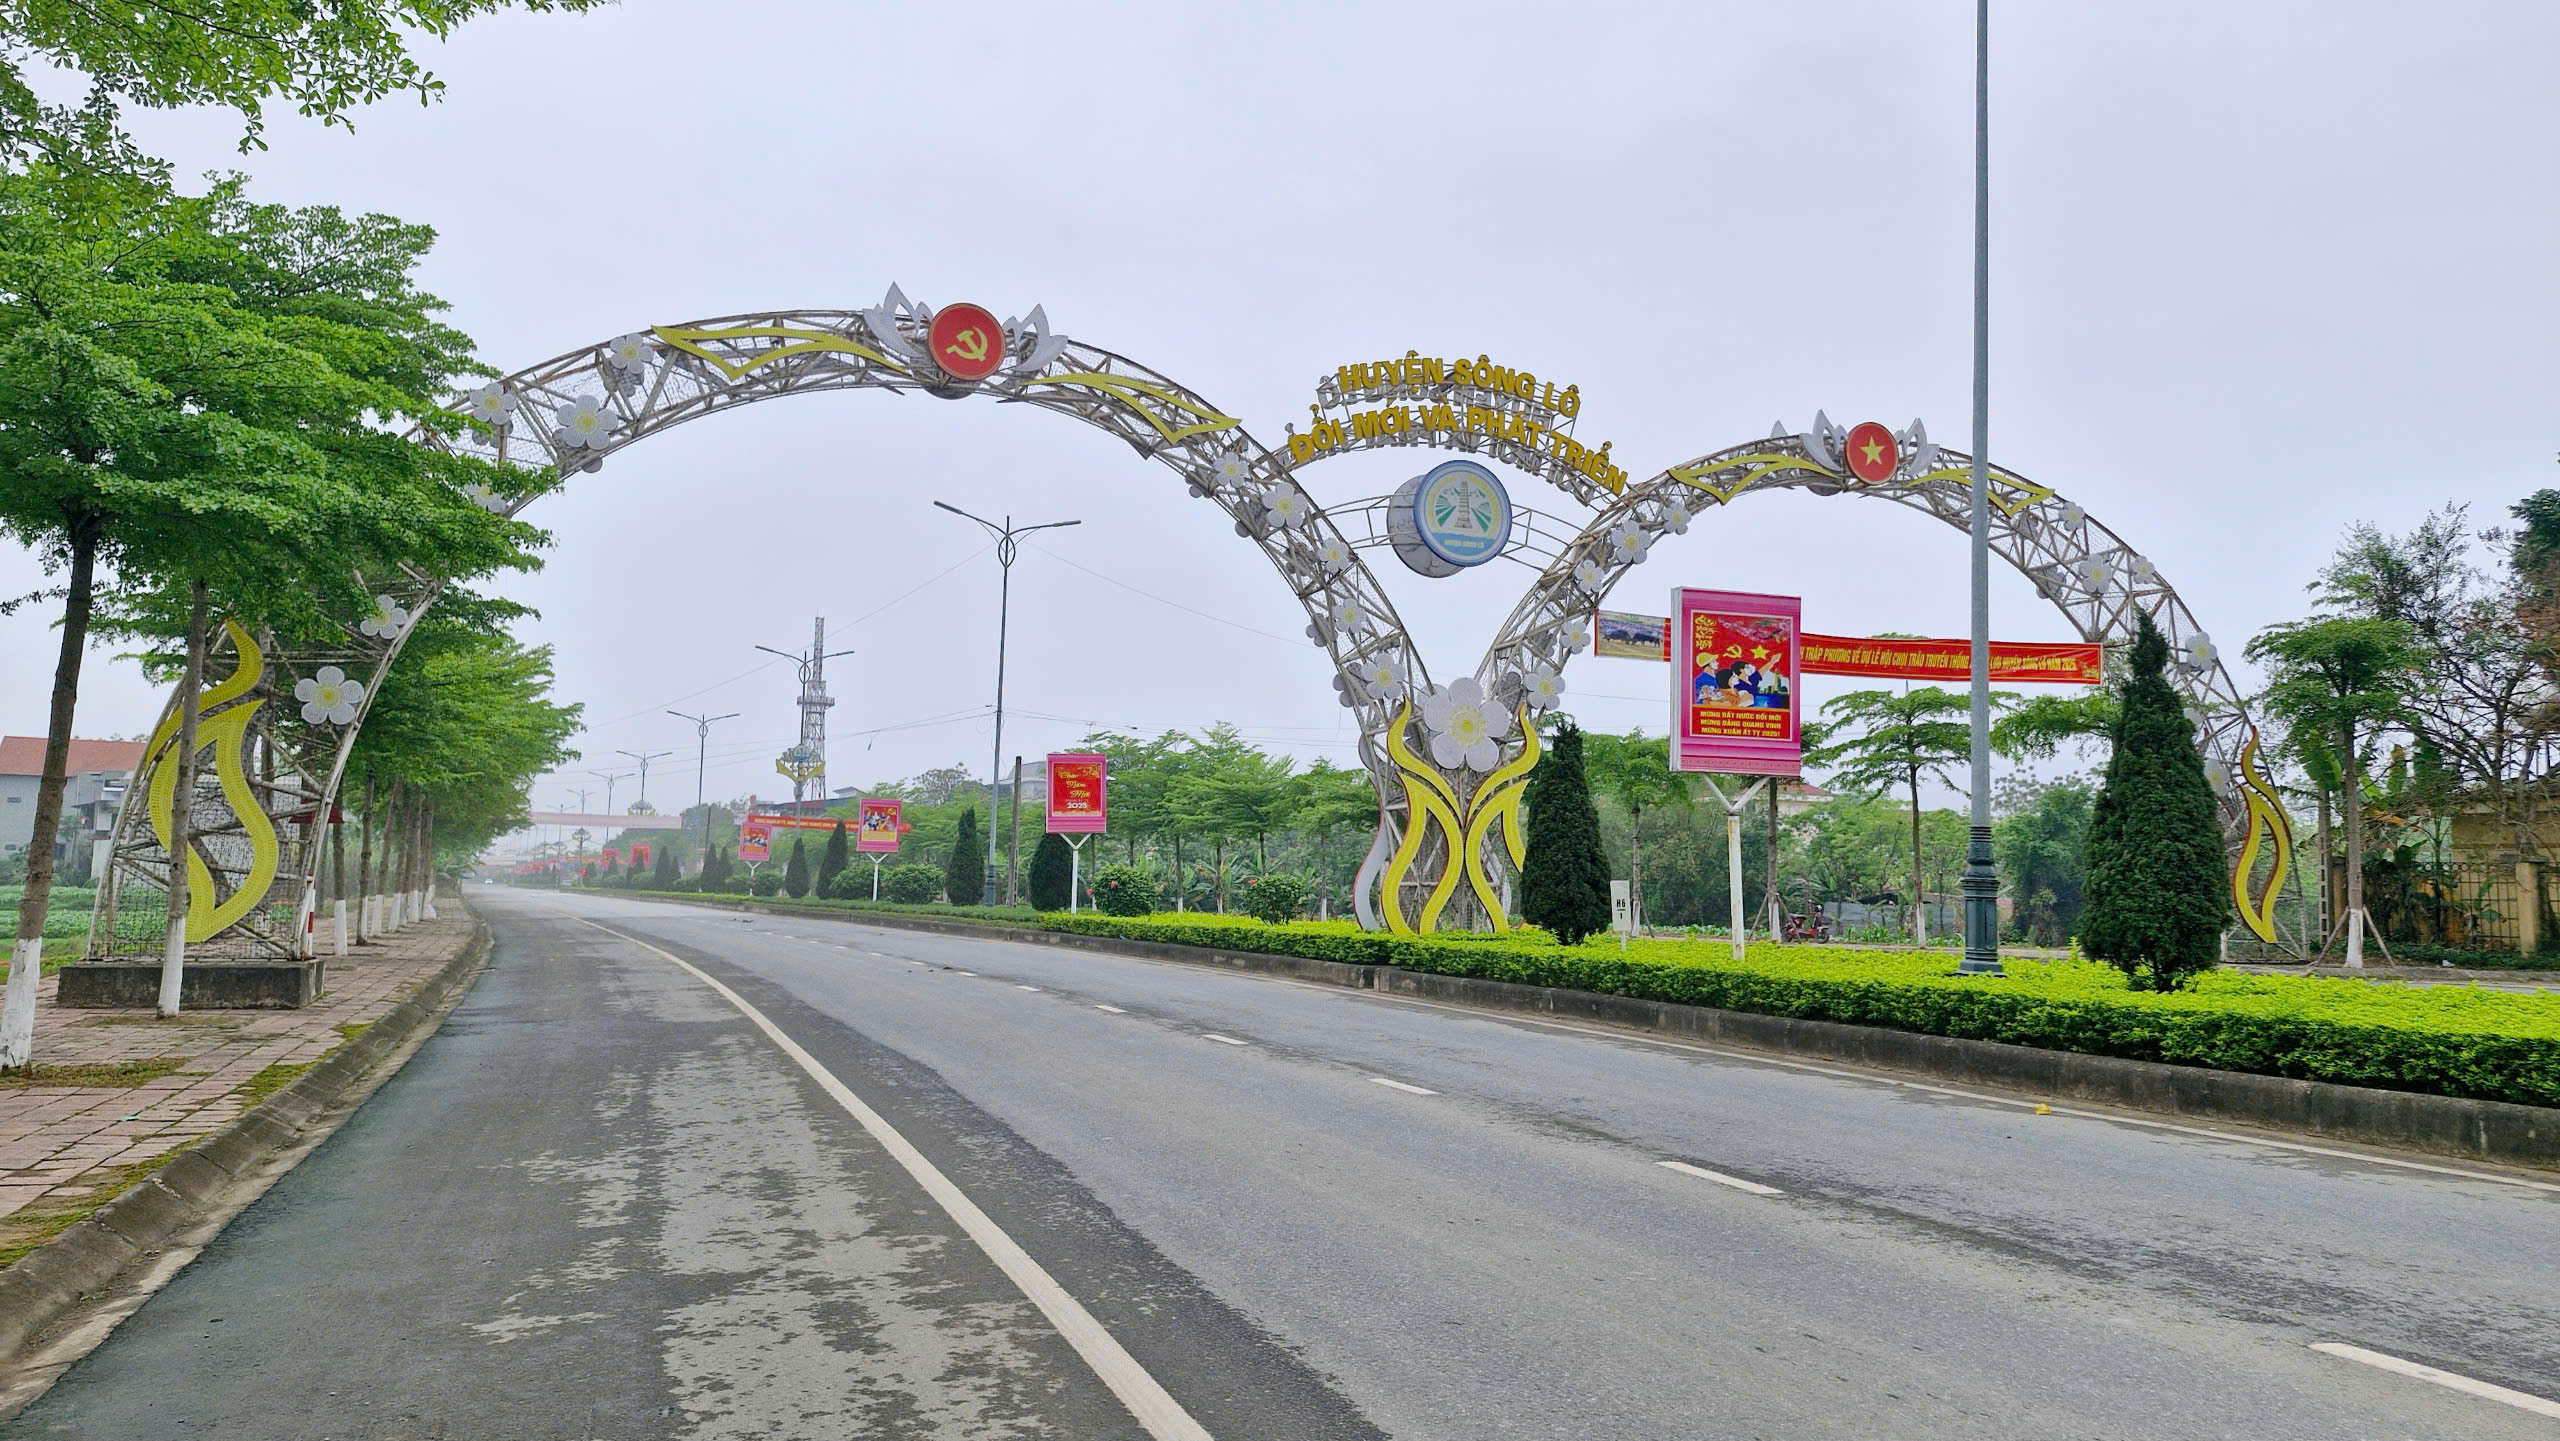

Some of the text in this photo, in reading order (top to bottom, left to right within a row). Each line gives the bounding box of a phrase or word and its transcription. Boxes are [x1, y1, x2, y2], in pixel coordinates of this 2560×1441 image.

[1338, 350, 1581, 418] HUYỆN SÔNG LÔ
[1288, 404, 1346, 464] ĐỔI
[1352, 395, 1411, 440] MỚI
[1420, 394, 1459, 432] VÀ
[1466, 405, 1546, 449] PHÁT
[1550, 440, 1629, 497] TRIỂN
